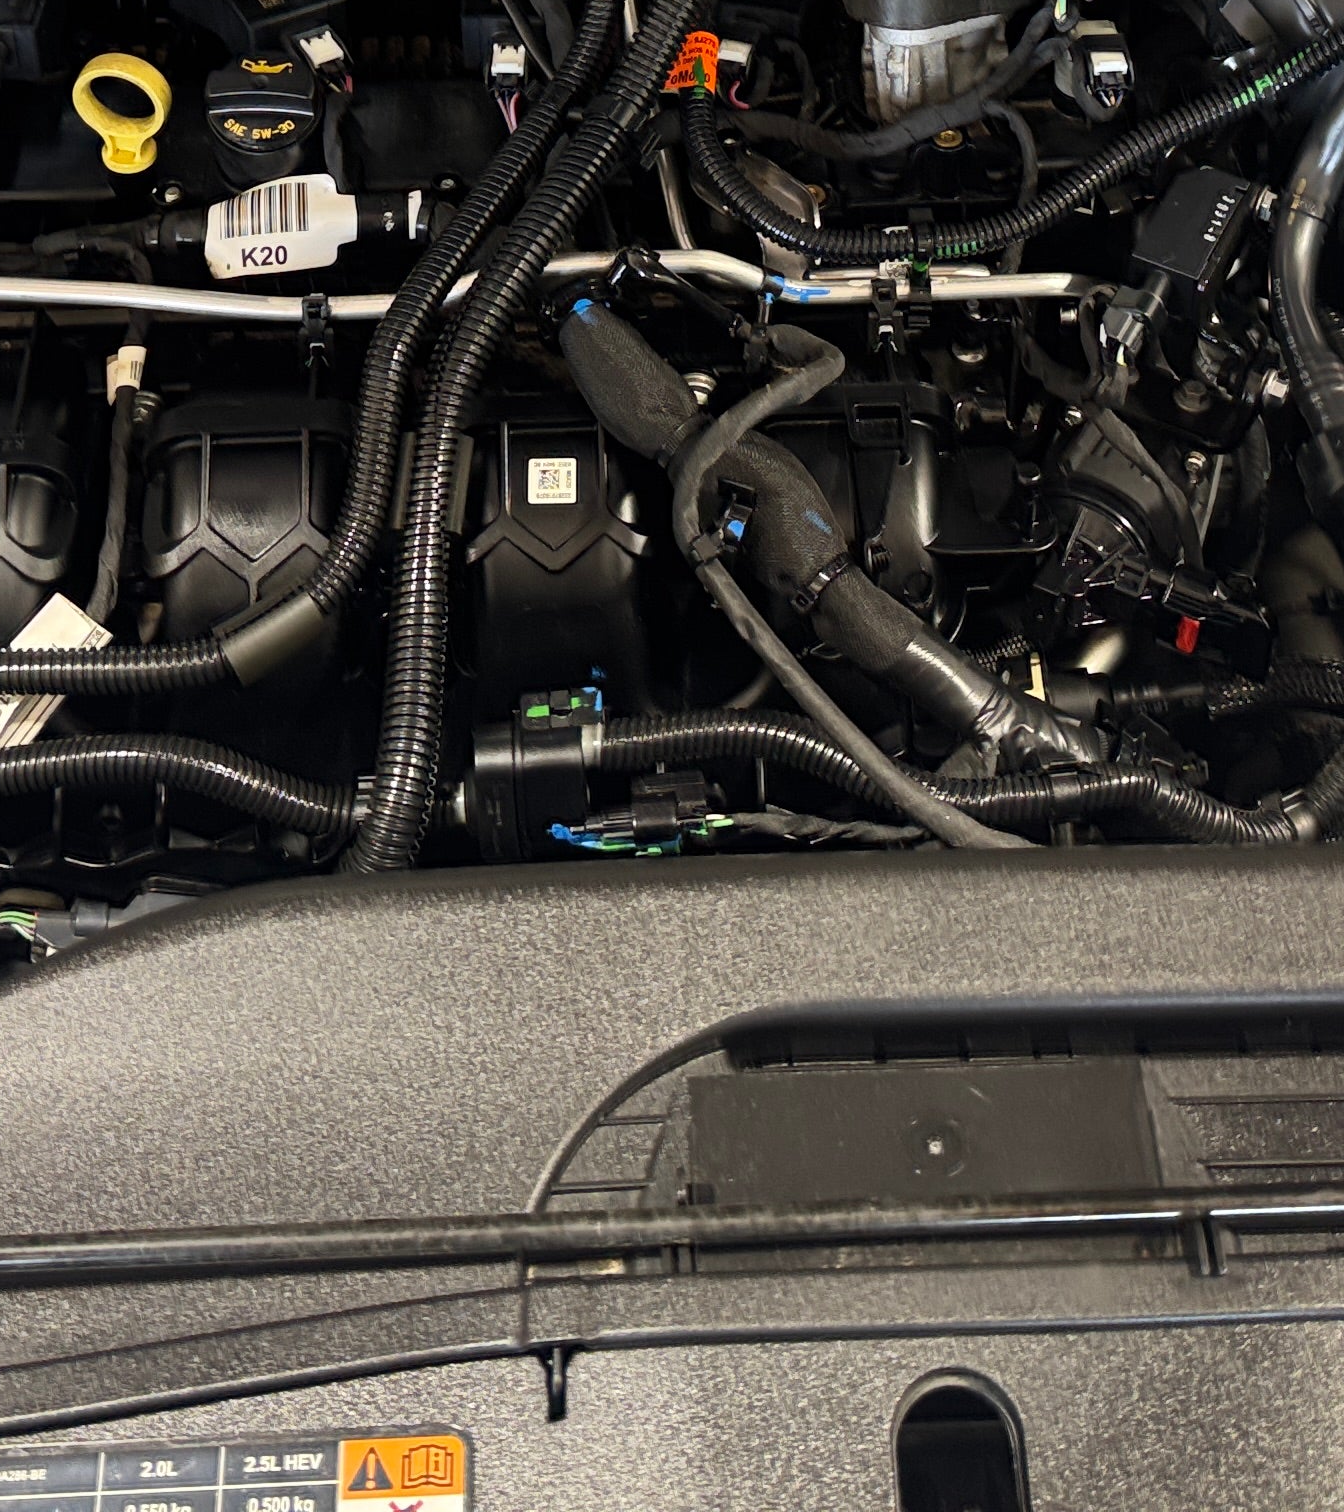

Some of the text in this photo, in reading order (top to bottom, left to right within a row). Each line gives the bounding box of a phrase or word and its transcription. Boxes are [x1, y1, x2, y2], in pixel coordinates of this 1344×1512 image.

[671, 70, 711, 85] oMoo
[223, 118, 296, 140] SAE 5W-30
[241, 245, 288, 268] K20
[139, 1460, 178, 1478] 2.0L
[243, 1453, 324, 1473] 2.5L HEV
